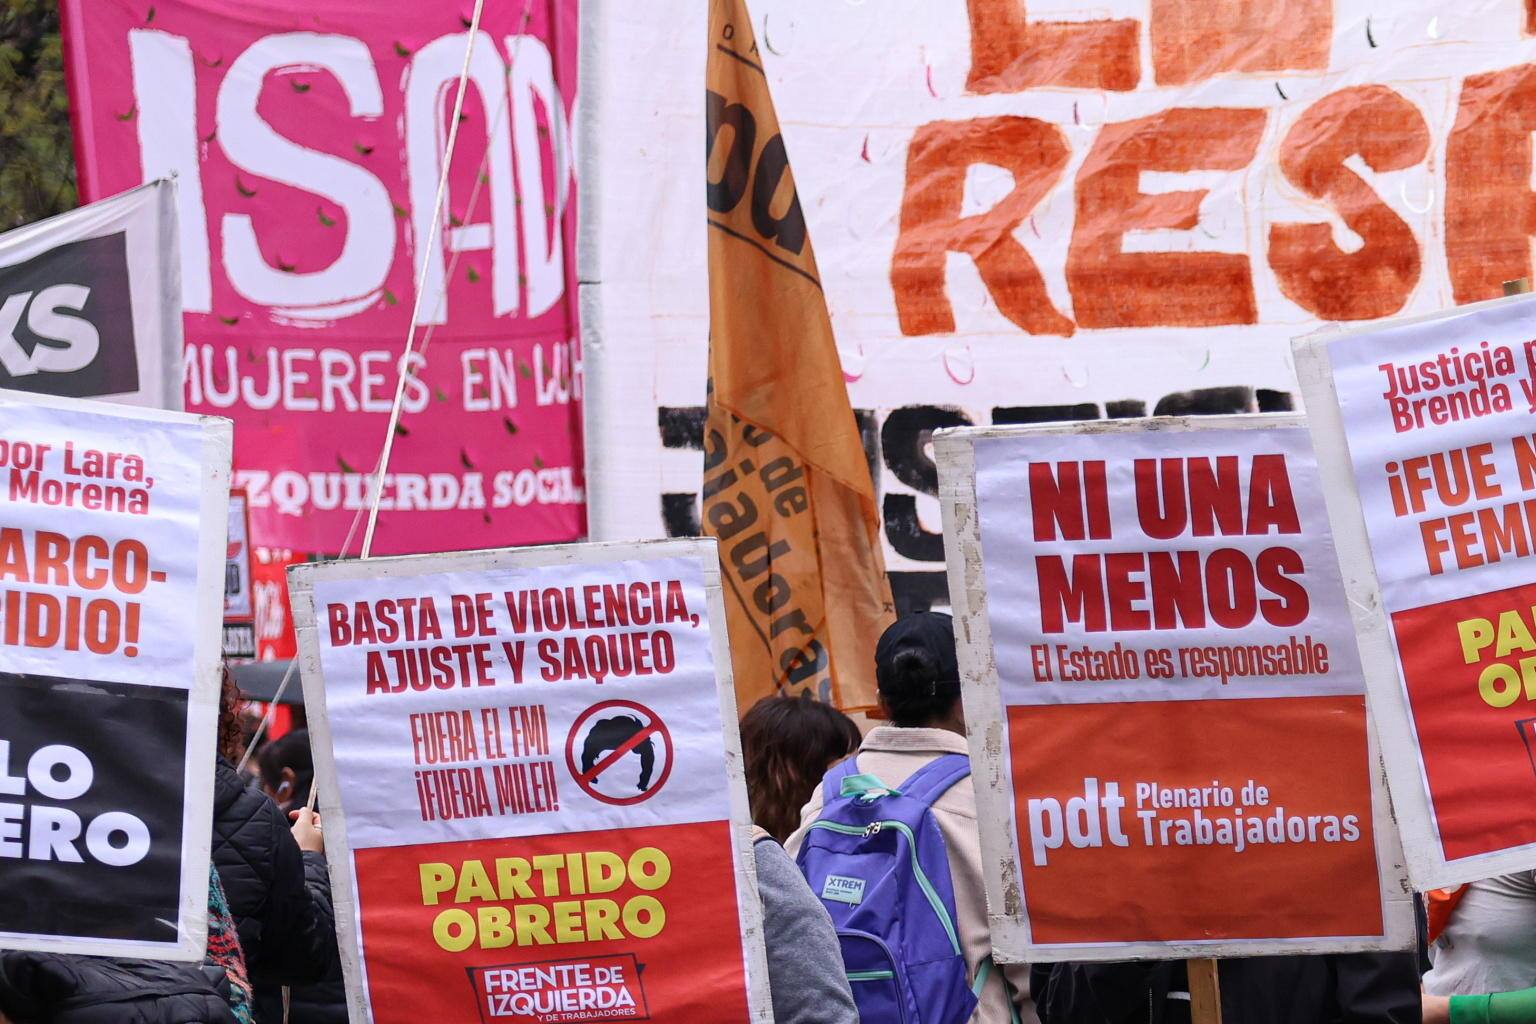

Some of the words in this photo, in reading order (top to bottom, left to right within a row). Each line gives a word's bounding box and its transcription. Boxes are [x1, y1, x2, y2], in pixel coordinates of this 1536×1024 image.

[127, 28, 578, 326] ISAD
[461, 347, 518, 412] EN
[1378, 341, 1515, 400] Justicia
[1387, 380, 1513, 433] Brenda
[9, 468, 149, 515] Morena
[64, 441, 154, 489] Lara,
[232, 470, 483, 516] ZQUIERDA
[1385, 442, 1503, 517] ¡FUE
[1028, 459, 1113, 541] NI
[1134, 454, 1302, 539] UNA
[327, 596, 442, 647] BASTA
[451, 593, 497, 638] DE
[504, 580, 700, 634] VIOLENCIA,
[1034, 546, 1310, 634] MENOS
[0, 590, 140, 657] IDIO!
[366, 643, 495, 695] AJUSTE
[502, 641, 525, 684] Y
[538, 630, 676, 685] SAQUEO
[1031, 644, 1054, 682] El
[1059, 642, 1140, 680] Estado
[1145, 647, 1174, 678] es
[1181, 635, 1330, 684] responsable
[410, 710, 476, 765] FUERA
[481, 707, 507, 760] EL
[509, 704, 549, 757] FMI
[415, 767, 493, 822] ¡FUERA
[1028, 777, 1128, 866] pdt
[1136, 780, 1234, 809] Plenario
[1241, 779, 1269, 806] de
[1137, 808, 1360, 852] Trabajadoras
[419, 847, 672, 906] PARTIDO
[828, 877, 862, 890] XTREM
[432, 895, 666, 953] OBRERO
[484, 964, 592, 992] FRENTE
[595, 966, 625, 985] DE
[488, 985, 636, 1017] IZQUIERDA
[537, 1014, 544, 1022] Y
[546, 1013, 559, 1023] DE
[562, 1008, 636, 1021] TRABAJADORES
